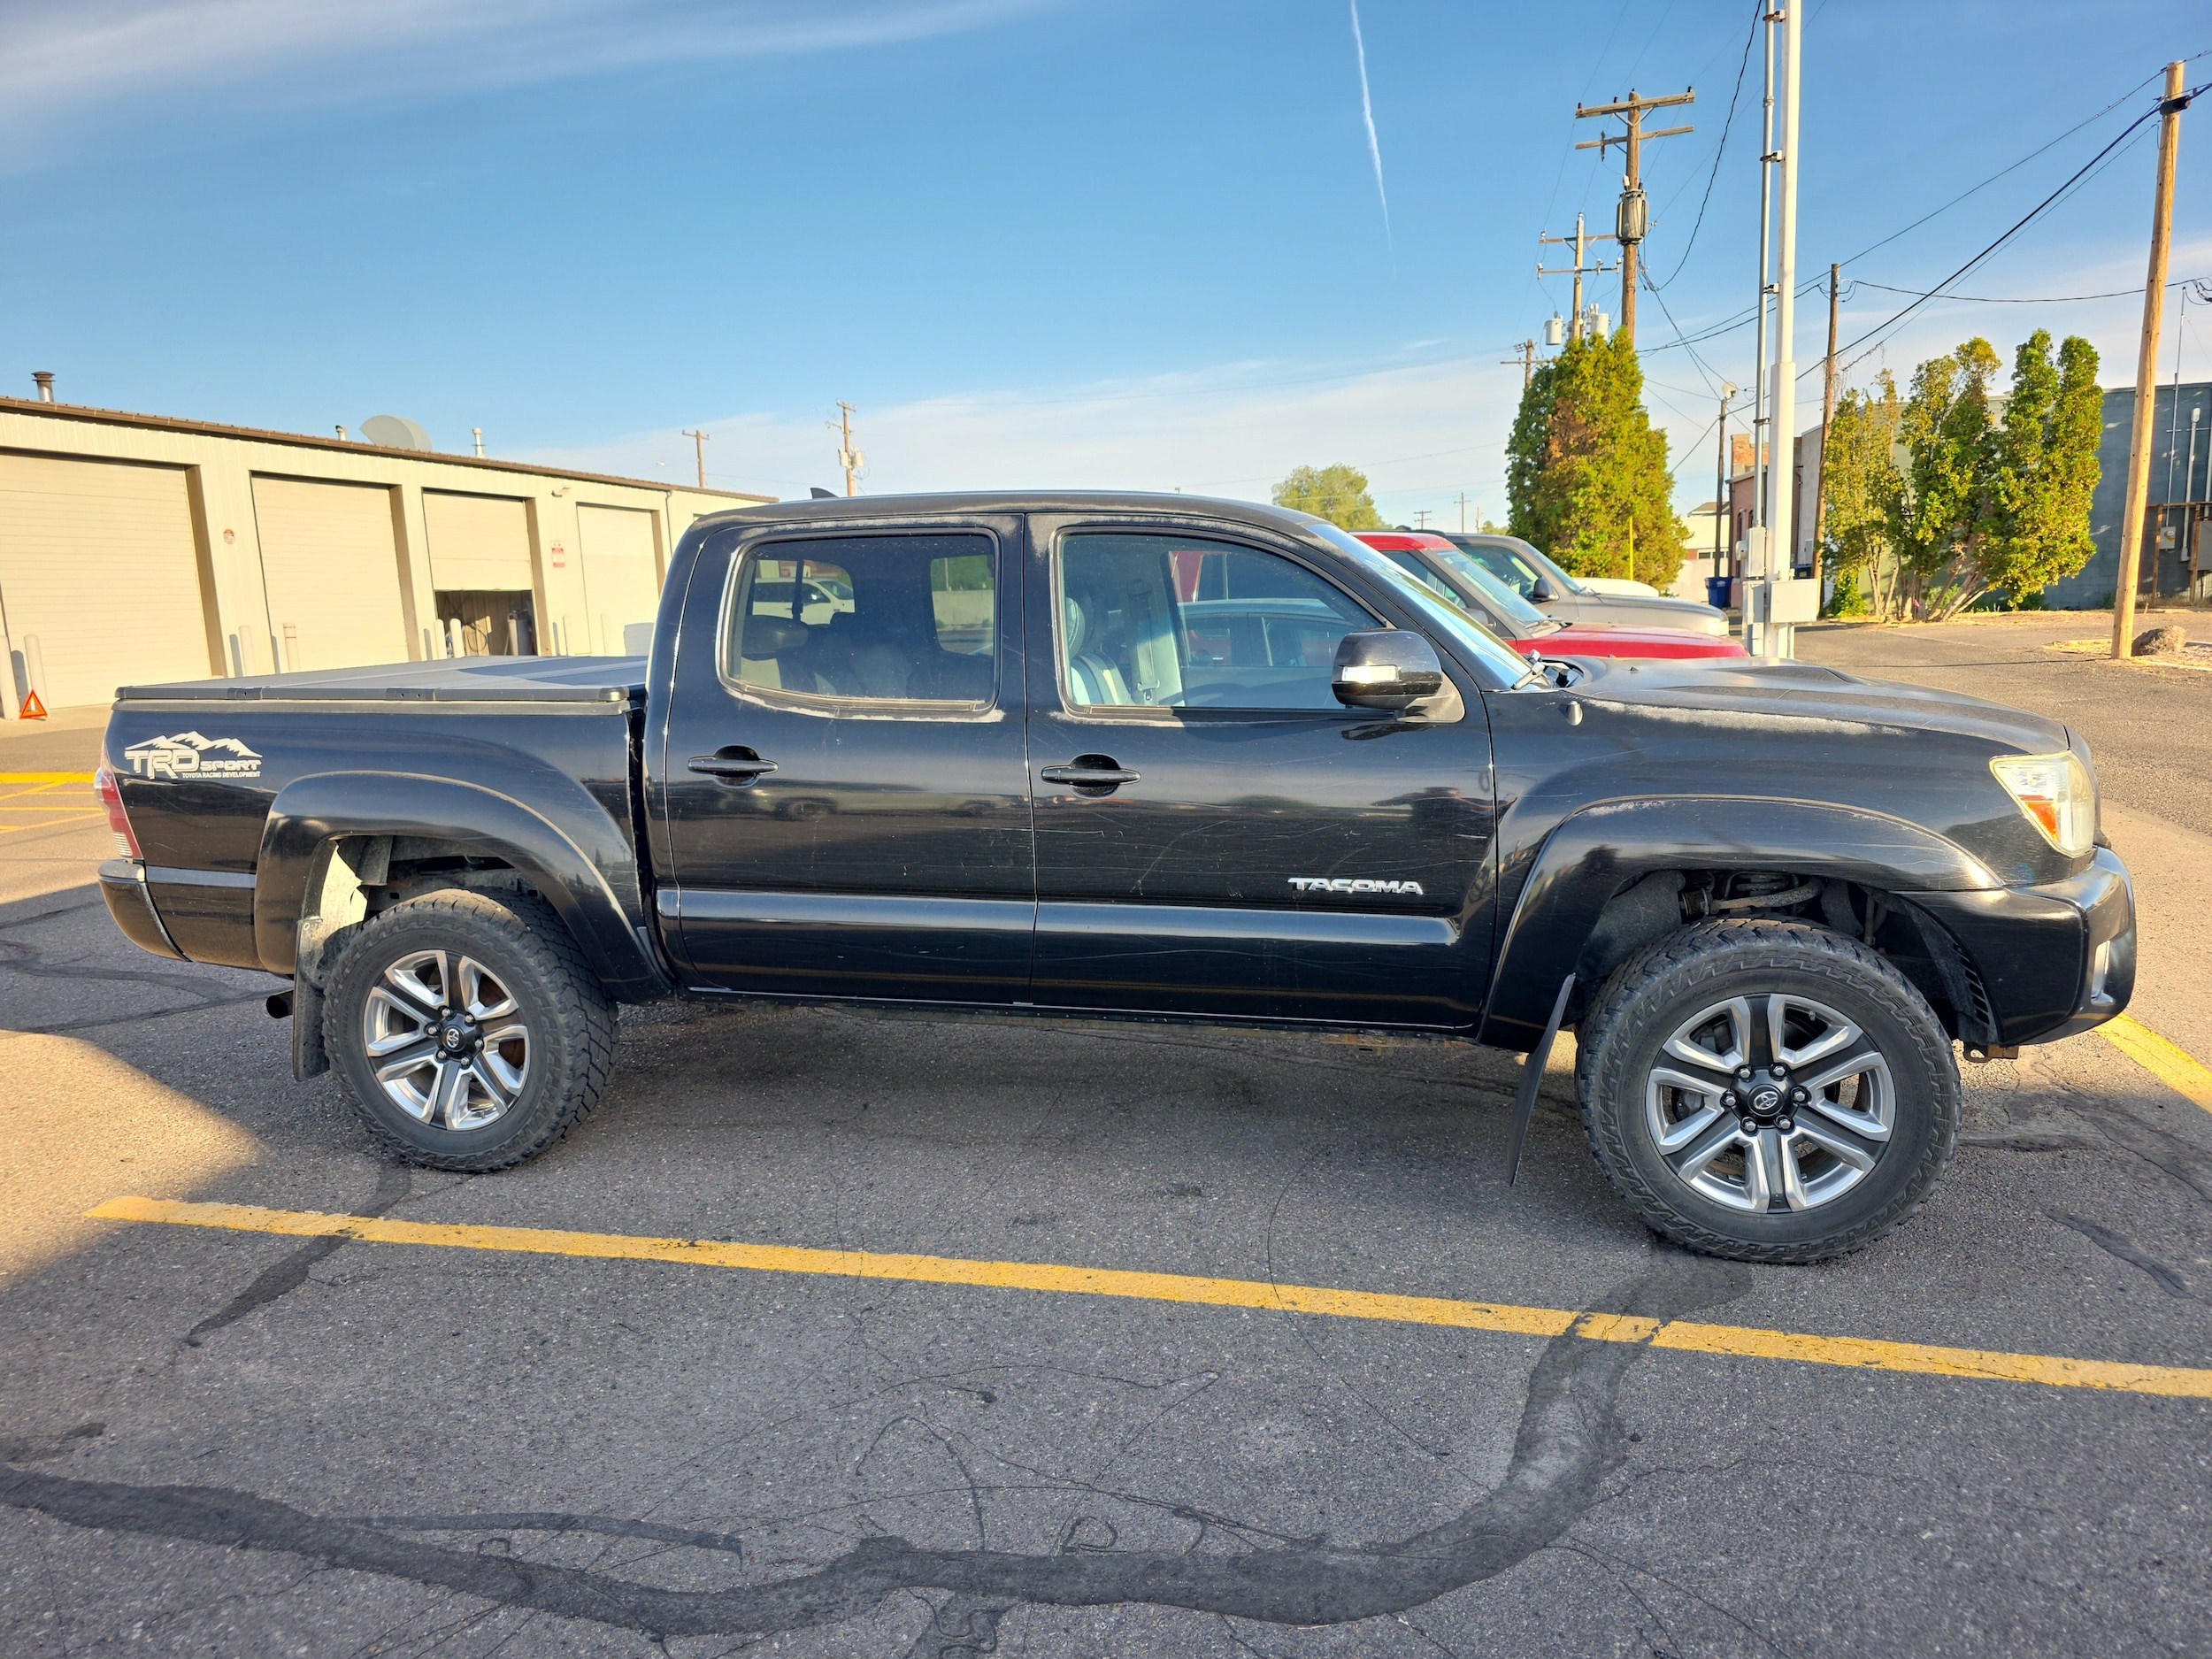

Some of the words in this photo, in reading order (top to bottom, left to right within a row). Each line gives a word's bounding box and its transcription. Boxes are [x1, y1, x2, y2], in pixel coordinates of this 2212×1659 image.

[125, 749, 200, 780] TRD
[200, 759, 262, 772] SPORT
[1286, 877, 1424, 895] TACOMA
